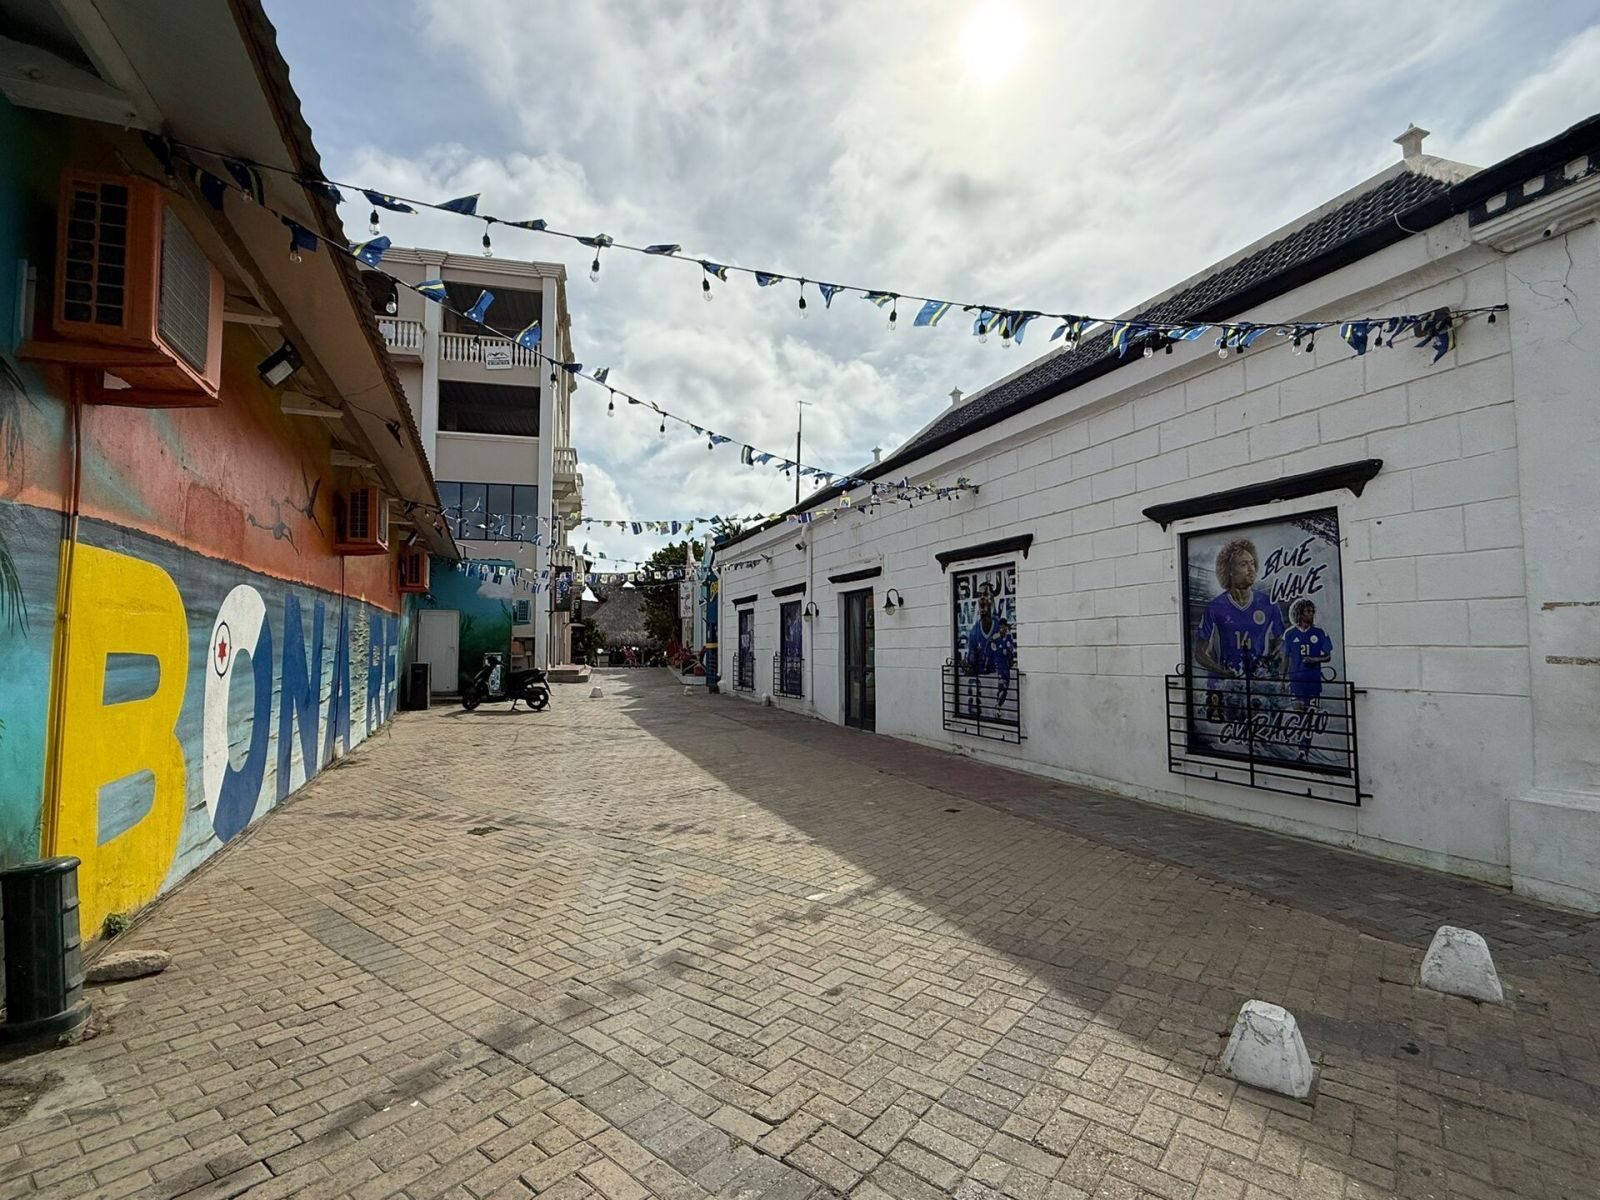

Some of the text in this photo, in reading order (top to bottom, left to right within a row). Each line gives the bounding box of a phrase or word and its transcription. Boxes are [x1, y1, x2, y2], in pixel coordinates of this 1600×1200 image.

[1262, 537, 1316, 580] BLUE
[1270, 564, 1328, 604] WAVE
[957, 597, 1016, 625] WVE
[1300, 644, 1310, 655] 21
